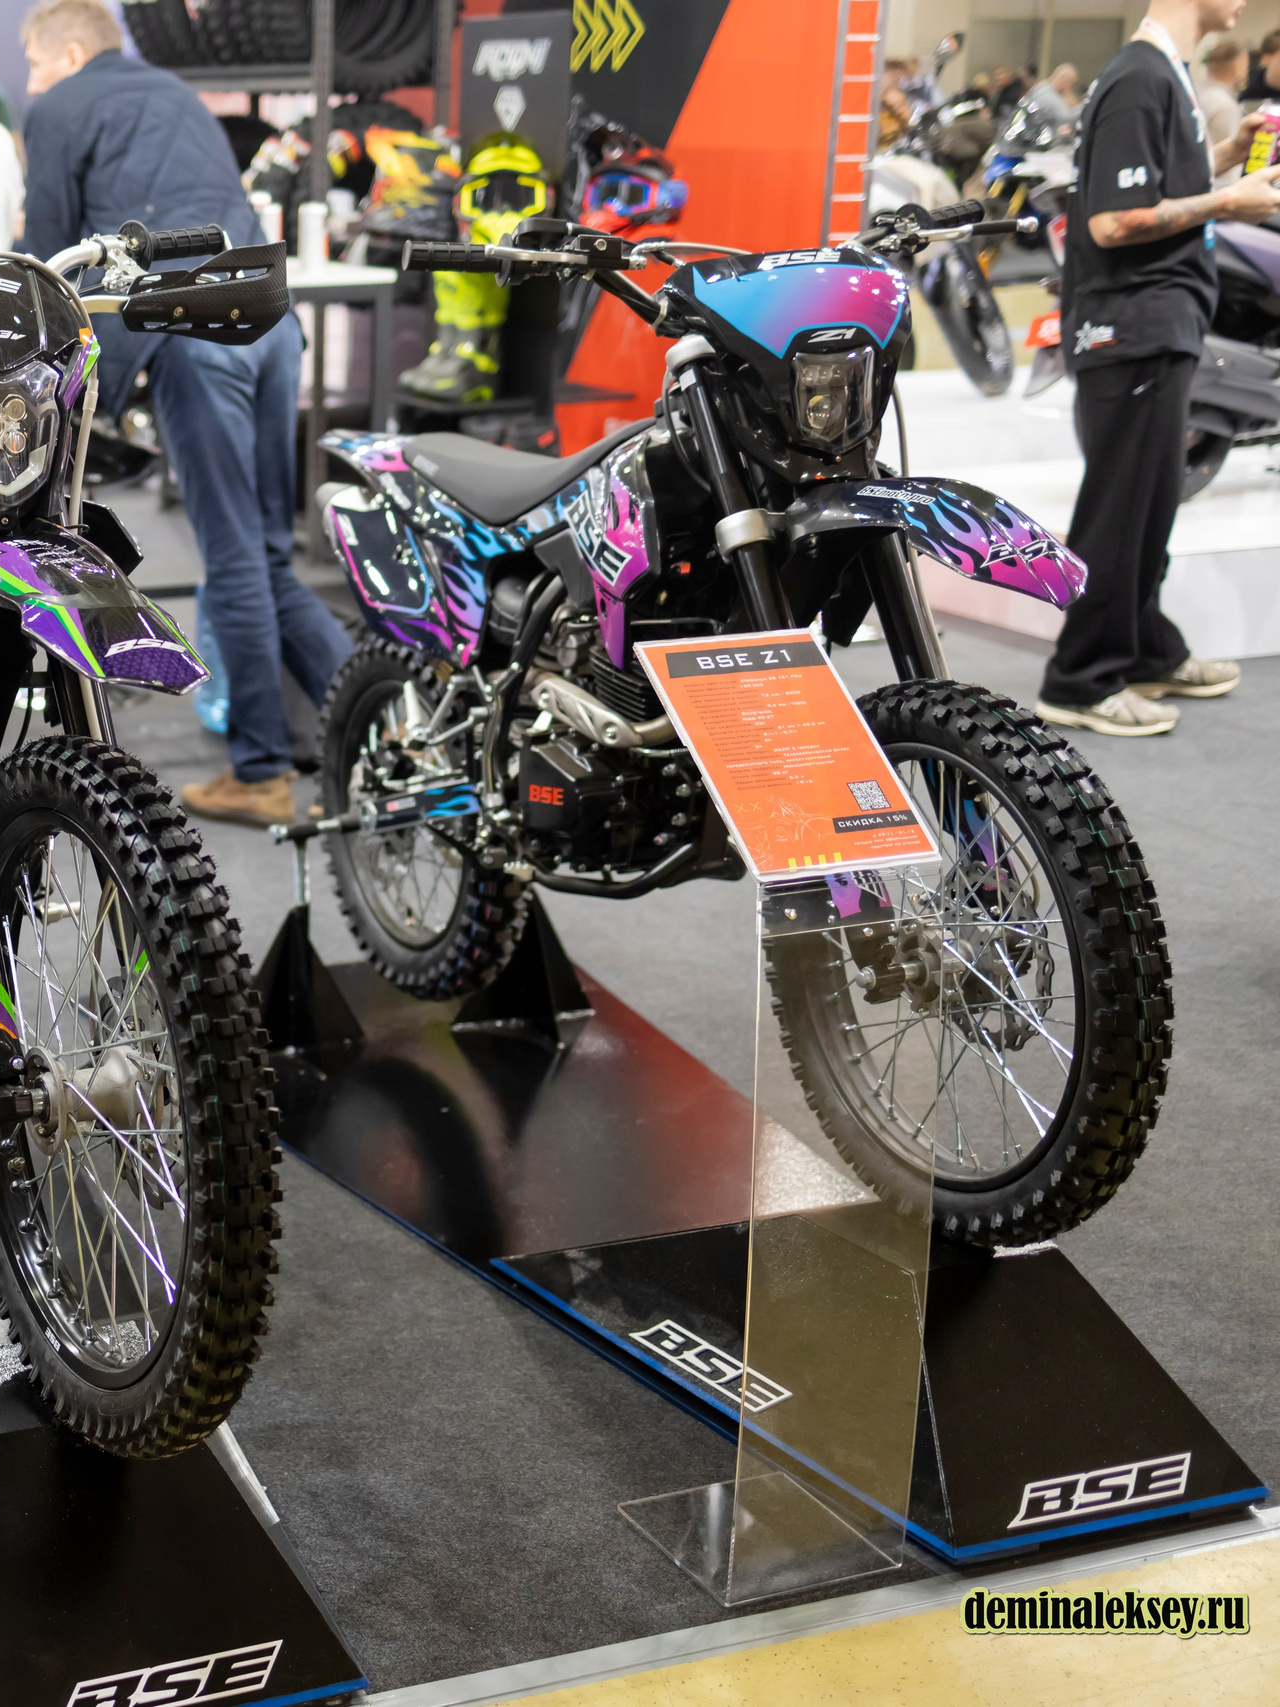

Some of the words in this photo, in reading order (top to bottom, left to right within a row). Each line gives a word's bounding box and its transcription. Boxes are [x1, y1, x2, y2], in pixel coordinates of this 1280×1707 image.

[758, 249, 842, 270] BSE
[807, 327, 857, 344] Z1
[564, 489, 632, 587] BSE
[979, 538, 1066, 569] BS
[103, 638, 190, 658] BSE
[695, 655, 753, 670] BSE
[760, 649, 792, 664] Z1
[529, 784, 564, 806] BSE
[837, 816, 884, 828] СКИДКА
[886, 813, 908, 822] 15%
[44, 1326, 61, 1352] BSE
[629, 1318, 792, 1414] BSE
[1007, 1452, 1192, 1531] BSE
[66, 1639, 283, 1707] BSE
